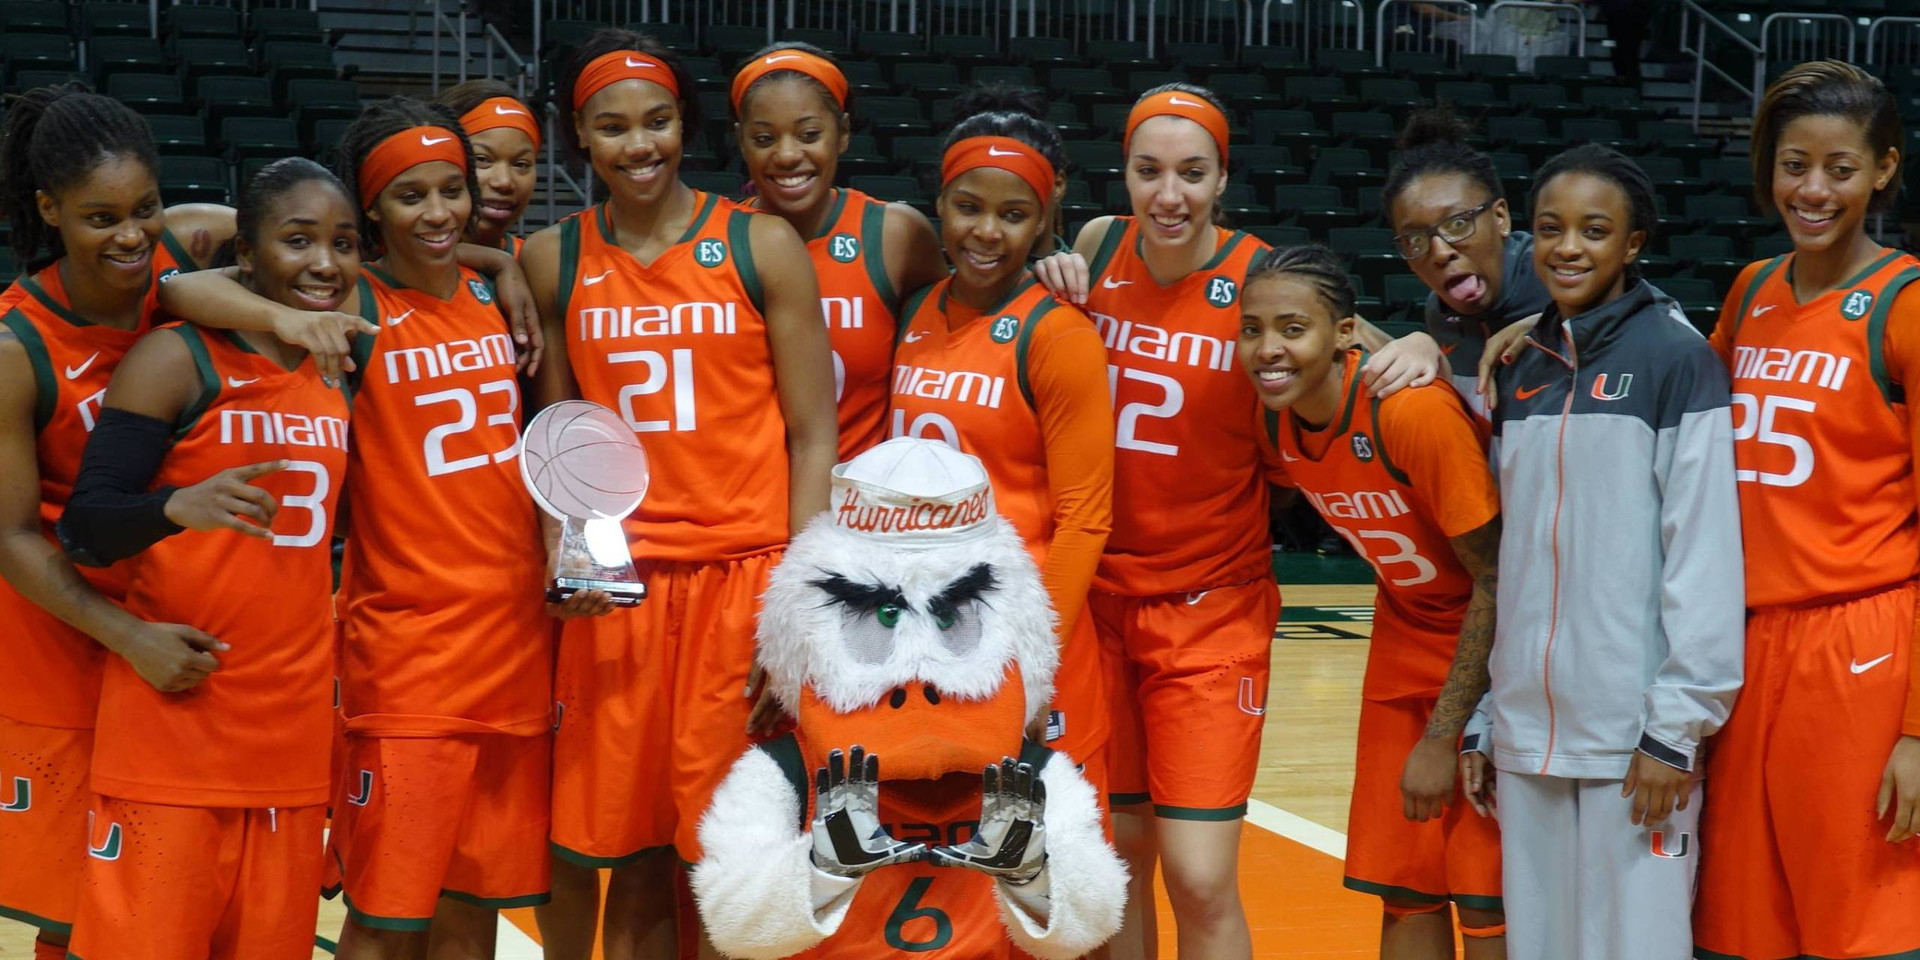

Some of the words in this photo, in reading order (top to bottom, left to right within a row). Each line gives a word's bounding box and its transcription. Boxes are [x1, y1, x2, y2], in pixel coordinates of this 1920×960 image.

[414, 379, 522, 477] 23
[607, 348, 697, 433] 21
[1731, 393, 1817, 488] 25
[272, 460, 330, 547] 3
[837, 486, 990, 533] Hurricanes
[884, 876, 953, 952] 6
